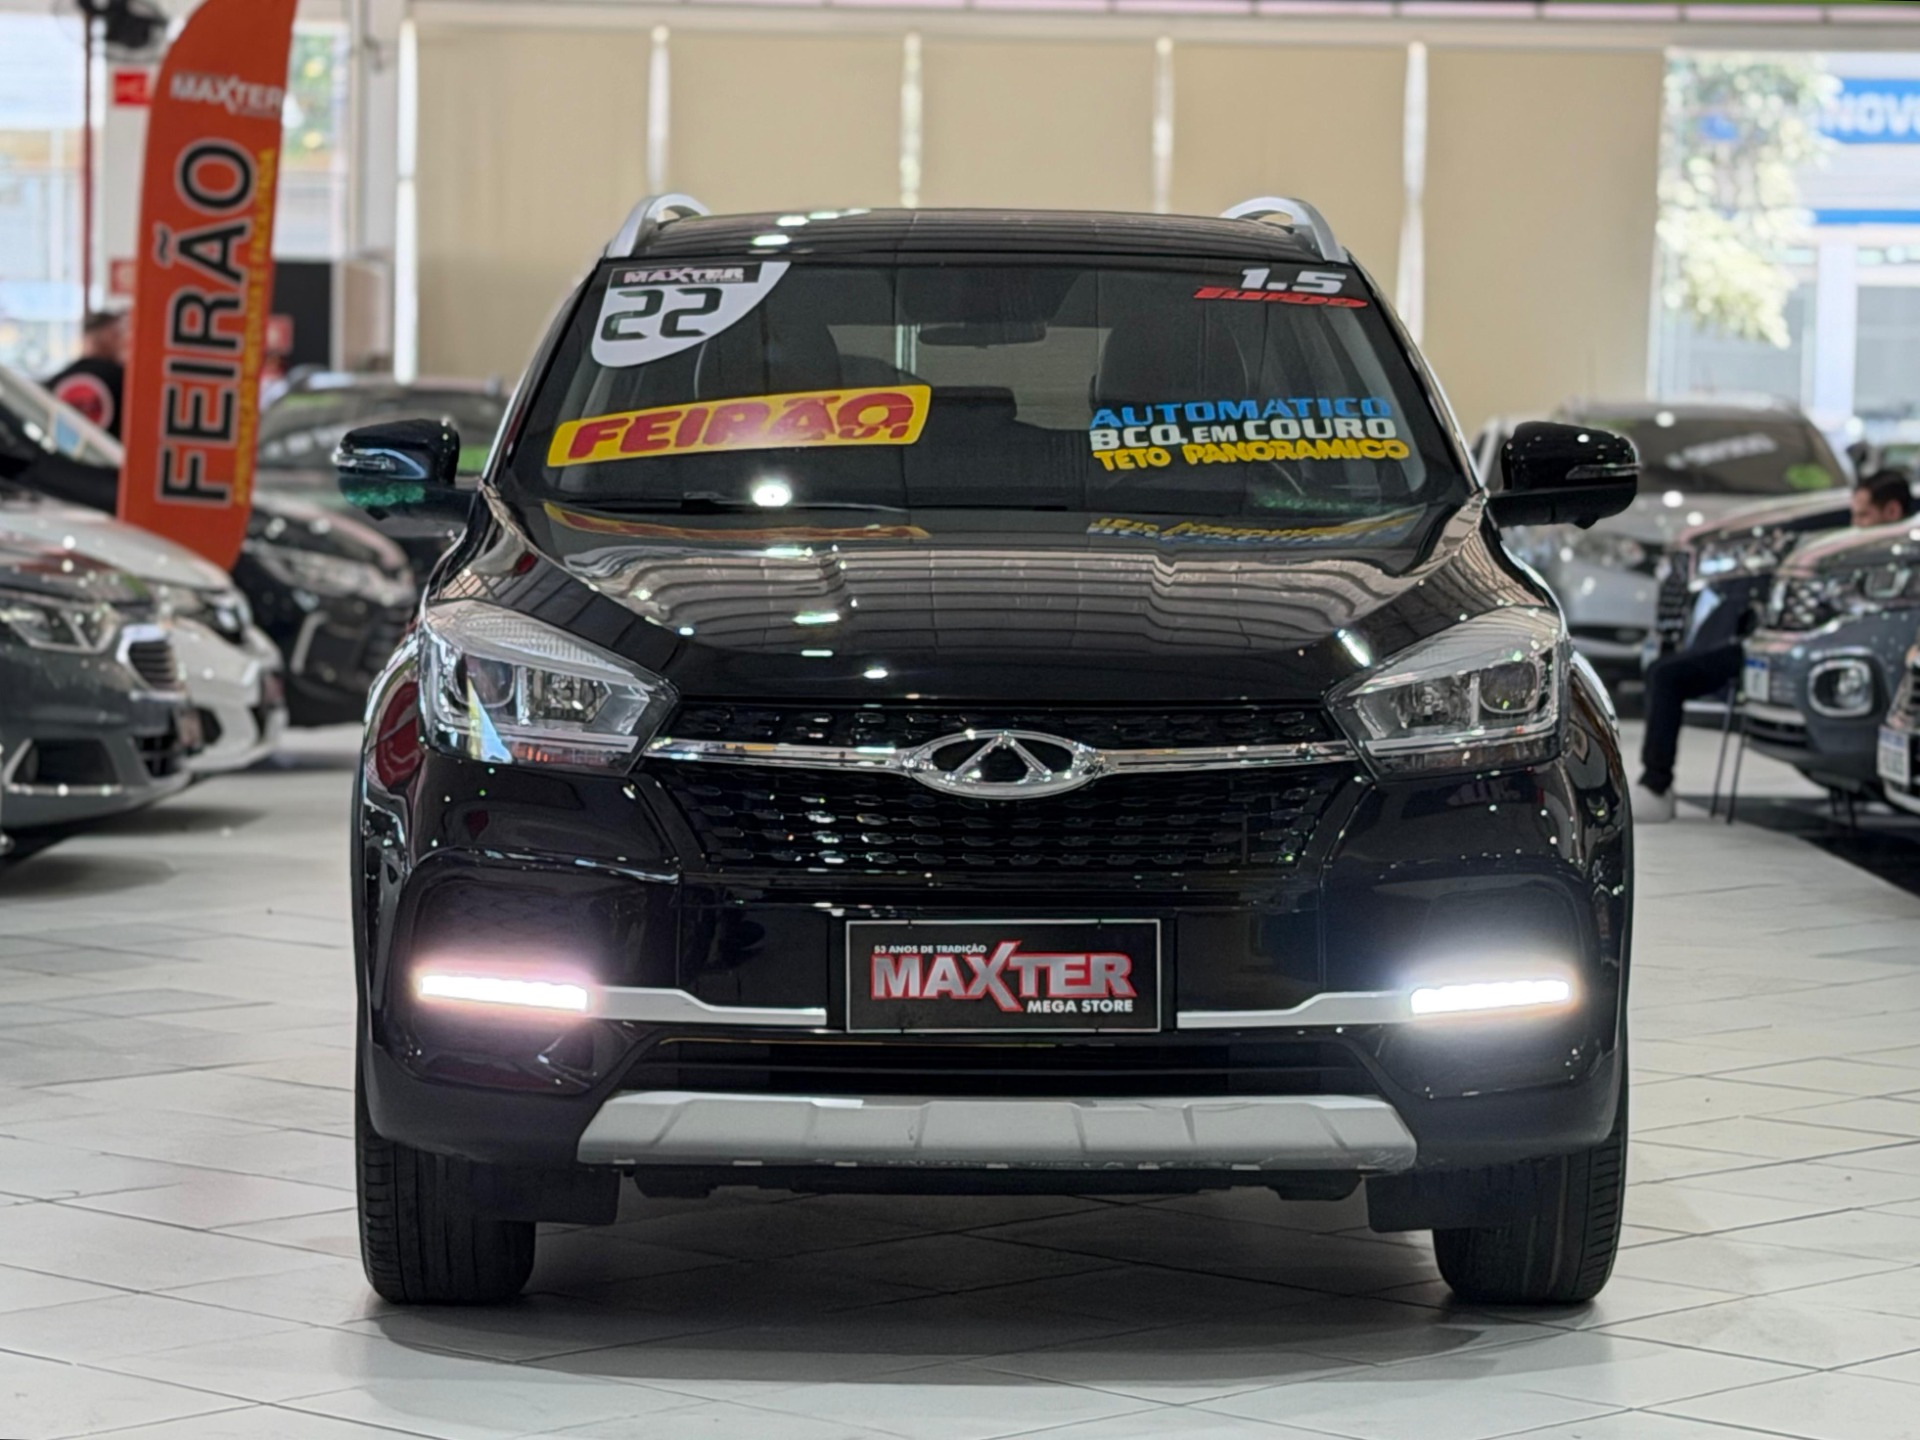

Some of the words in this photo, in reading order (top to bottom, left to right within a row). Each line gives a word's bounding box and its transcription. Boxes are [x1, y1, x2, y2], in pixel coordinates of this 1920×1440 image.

[169, 72, 285, 116] MAXTER
[623, 267, 744, 284] MAXTER
[1241, 268, 1347, 294] 1.5
[155, 138, 257, 507] FEIRÃO
[600, 287, 723, 342] 22
[568, 392, 914, 459] FEIRÃO
[1192, 425, 1238, 443] EM
[1243, 418, 1396, 440] COURO
[1093, 447, 1171, 472] TETO
[874, 945, 887, 954] 53
[888, 945, 918, 954] ANOS
[920, 945, 934, 954] DE
[936, 943, 987, 954] TRADIÇÃO
[871, 940, 1137, 1012] MAXTER
[1027, 1000, 1078, 1013] MEGA
[1081, 1000, 1133, 1013] STORE
